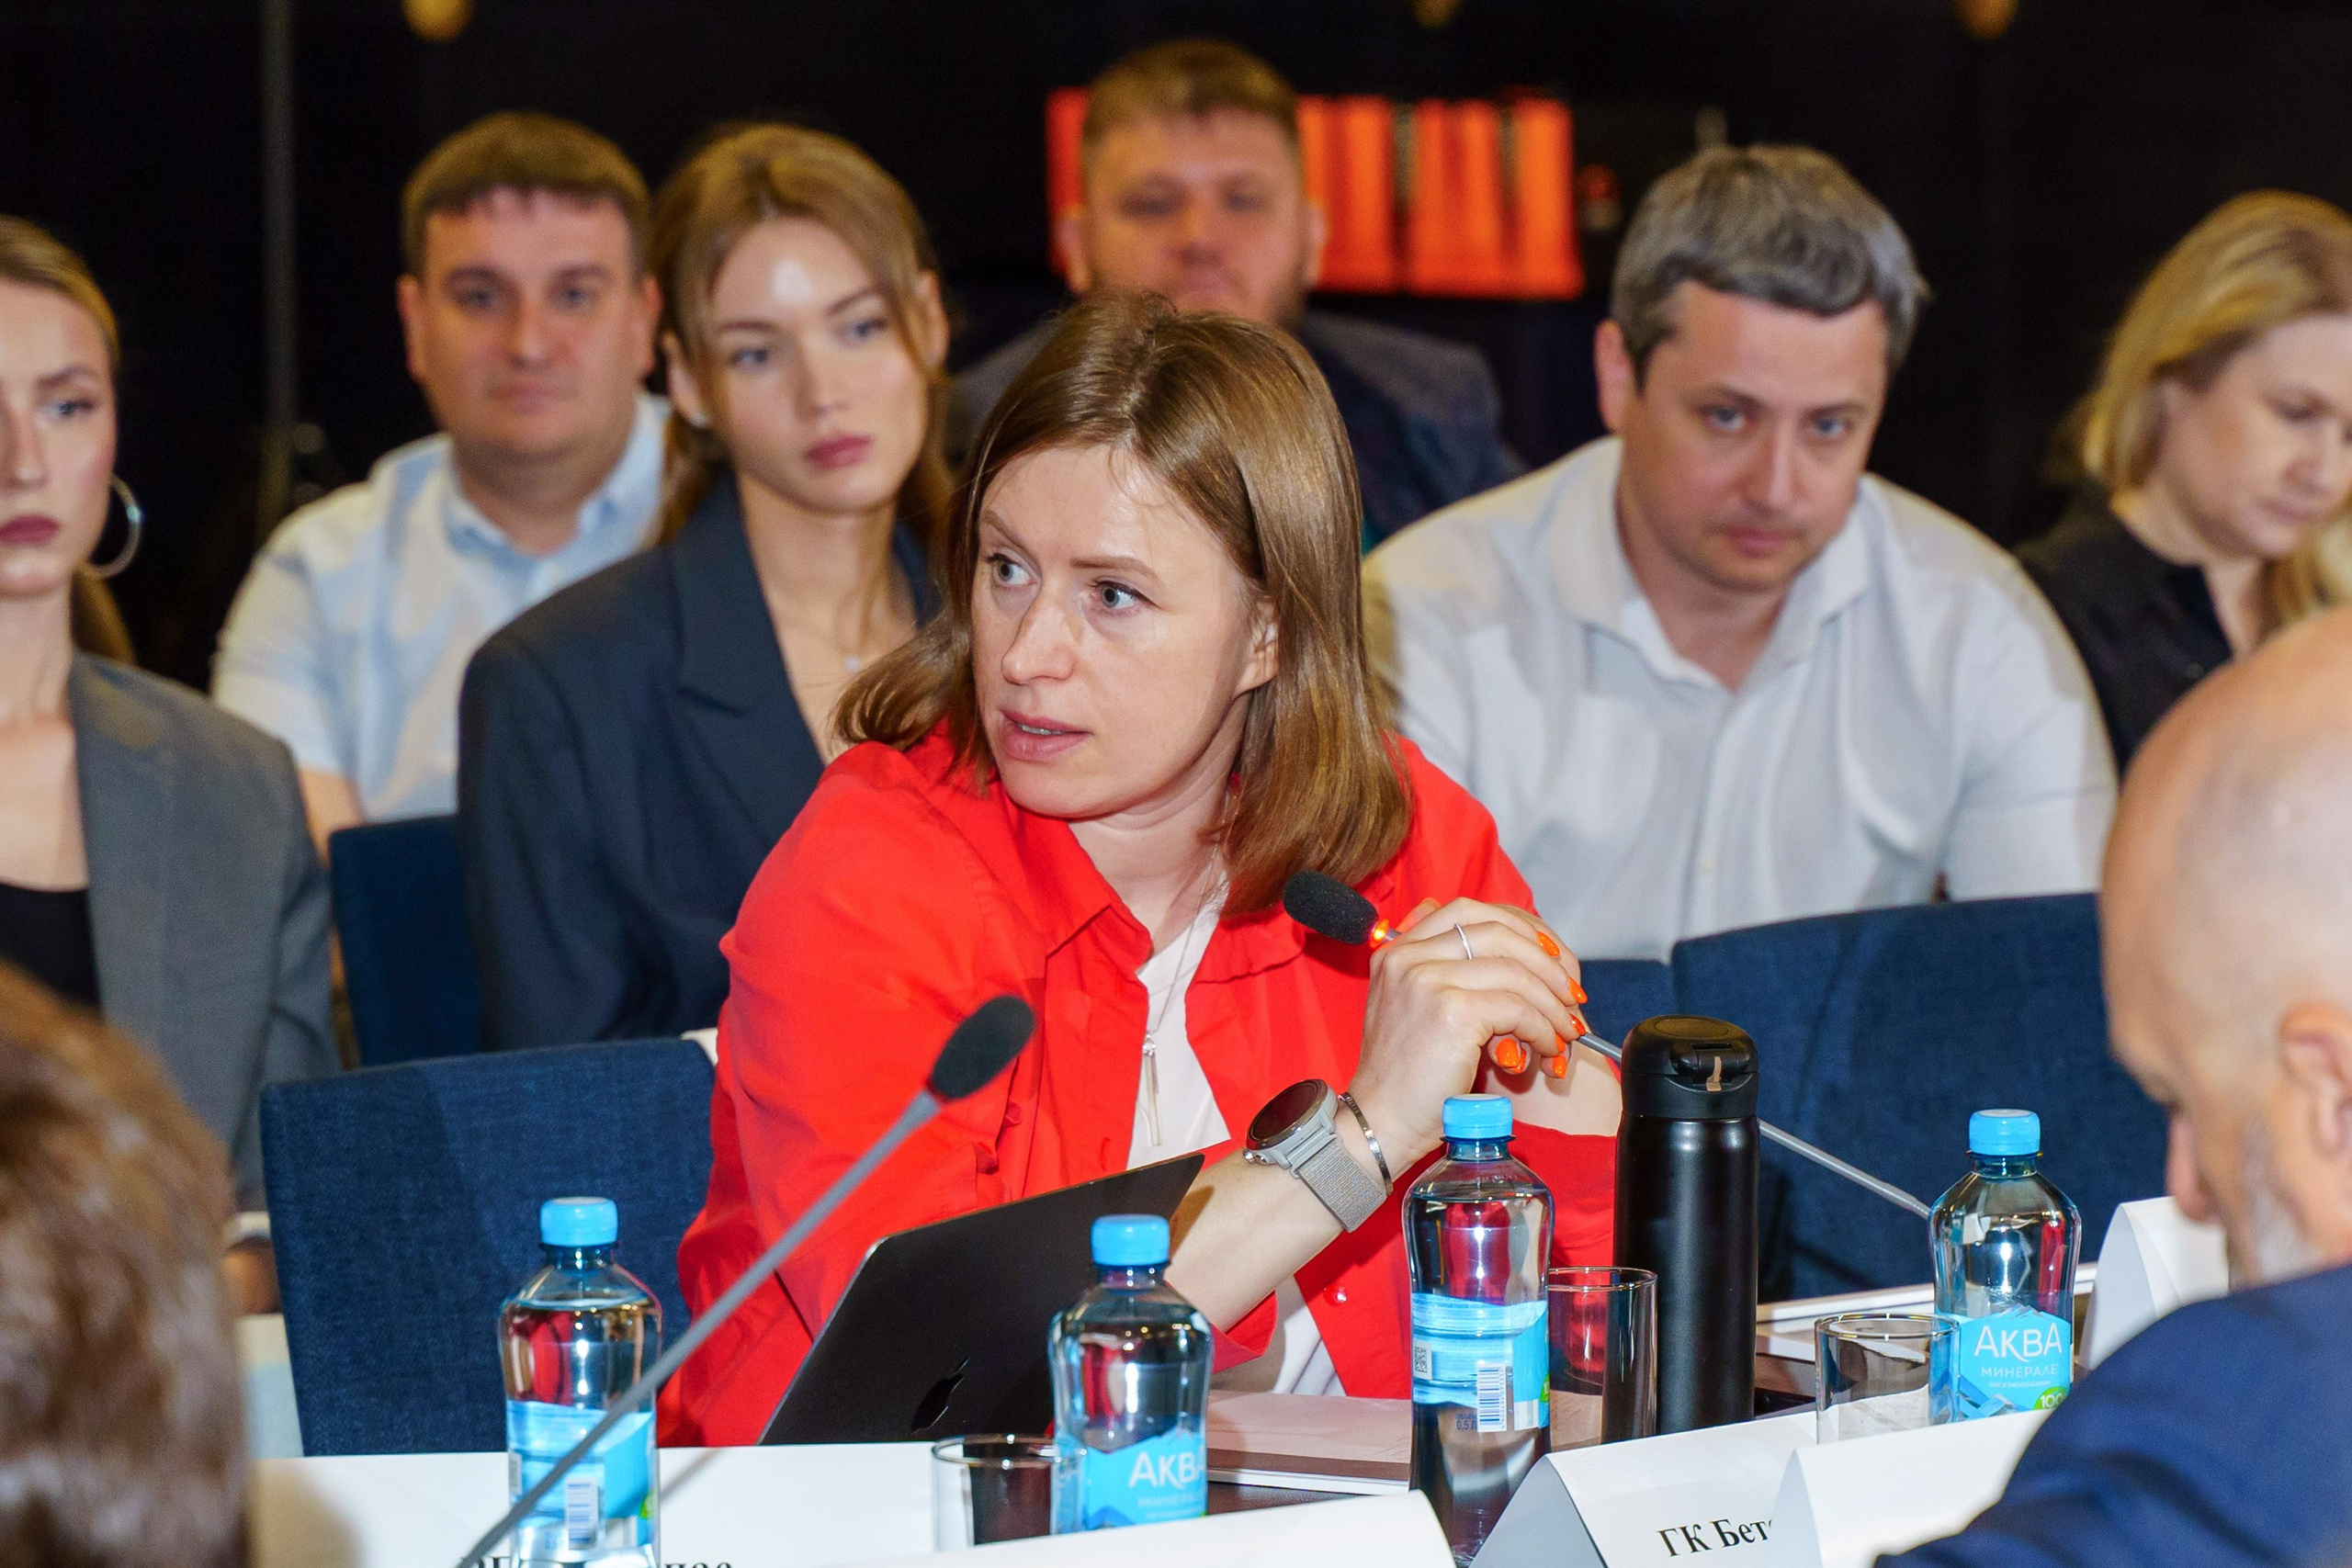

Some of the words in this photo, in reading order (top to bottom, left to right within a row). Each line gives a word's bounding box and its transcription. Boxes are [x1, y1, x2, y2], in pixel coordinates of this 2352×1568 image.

[1973, 1323, 2063, 1362] АКВА
[1981, 1363, 2058, 1378] МИНЕРАЛЕ
[1656, 1523, 1713, 1557] ГК
